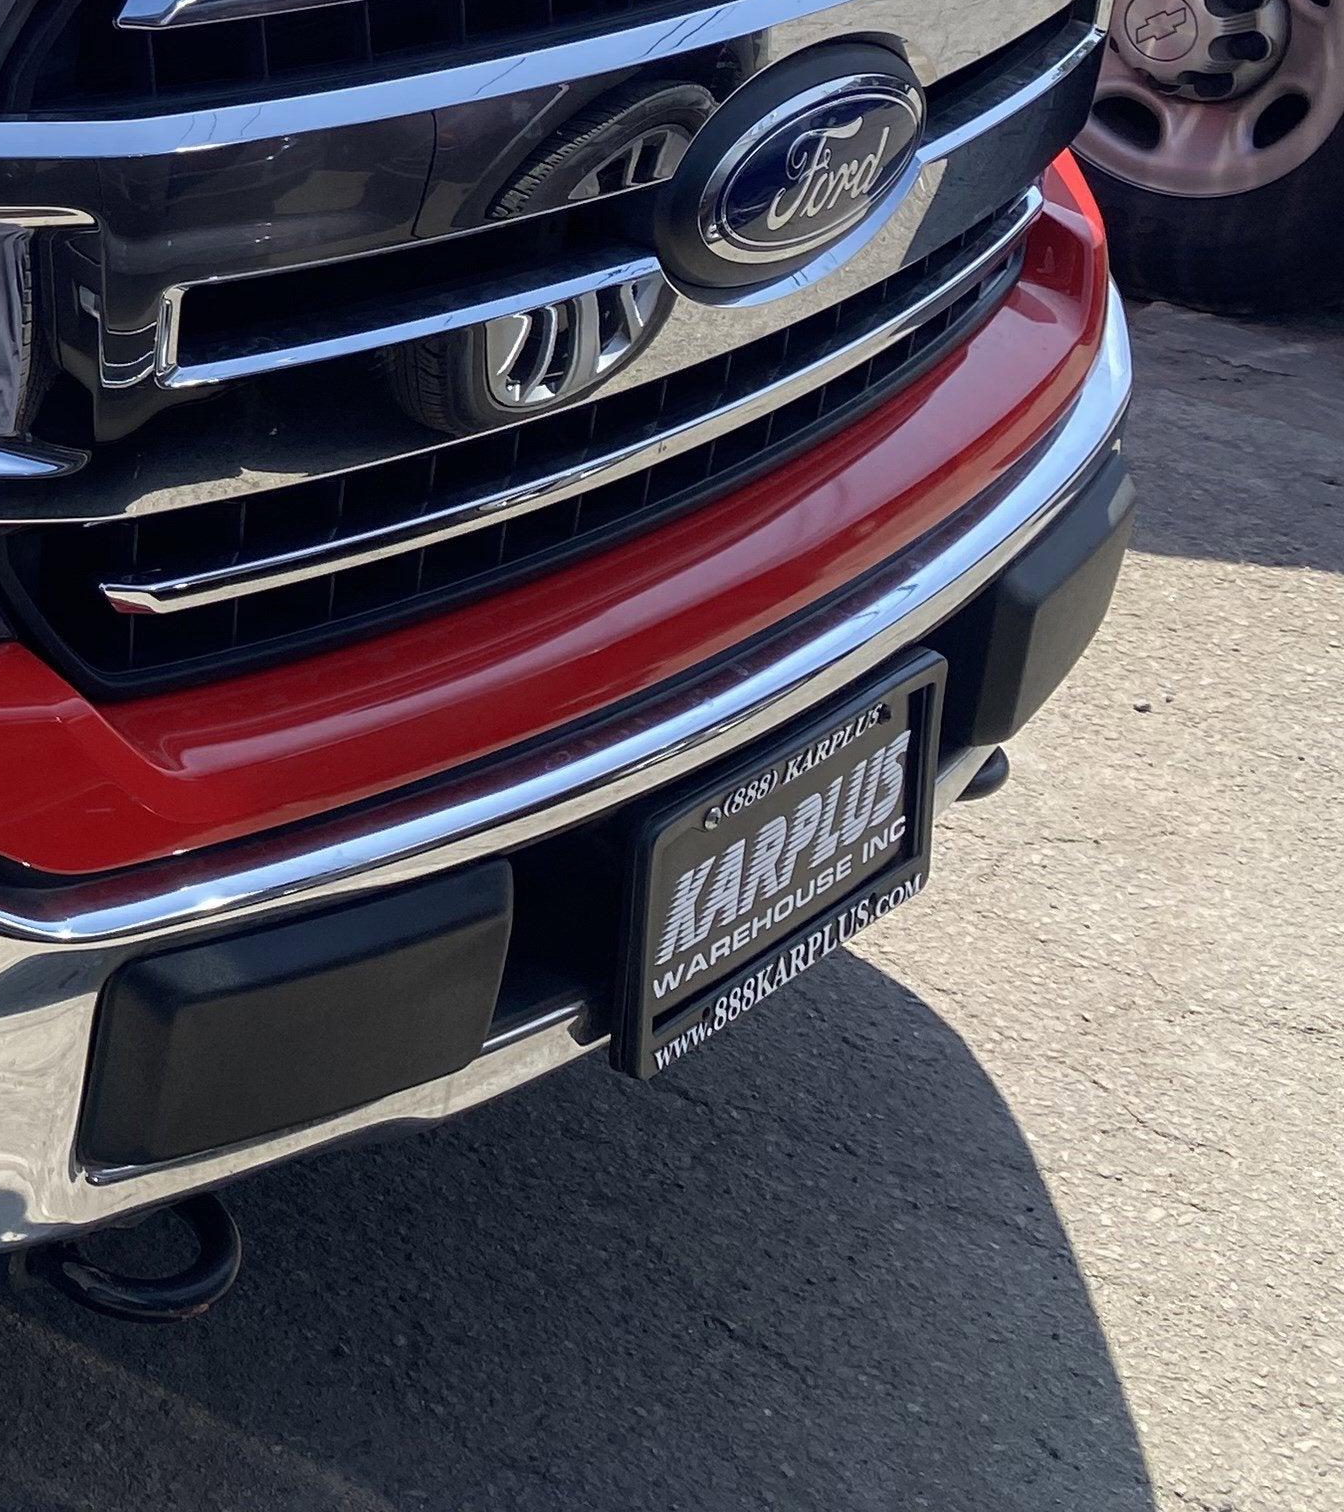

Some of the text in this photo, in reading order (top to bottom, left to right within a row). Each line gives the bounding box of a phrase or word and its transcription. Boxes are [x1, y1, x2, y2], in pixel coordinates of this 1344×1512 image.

[767, 115, 890, 231] Ford
[723, 702, 883, 817] (888) KARPLUS
[652, 815, 906, 999] WAREHOUSE INC
[654, 729, 912, 966] KARPLUS
